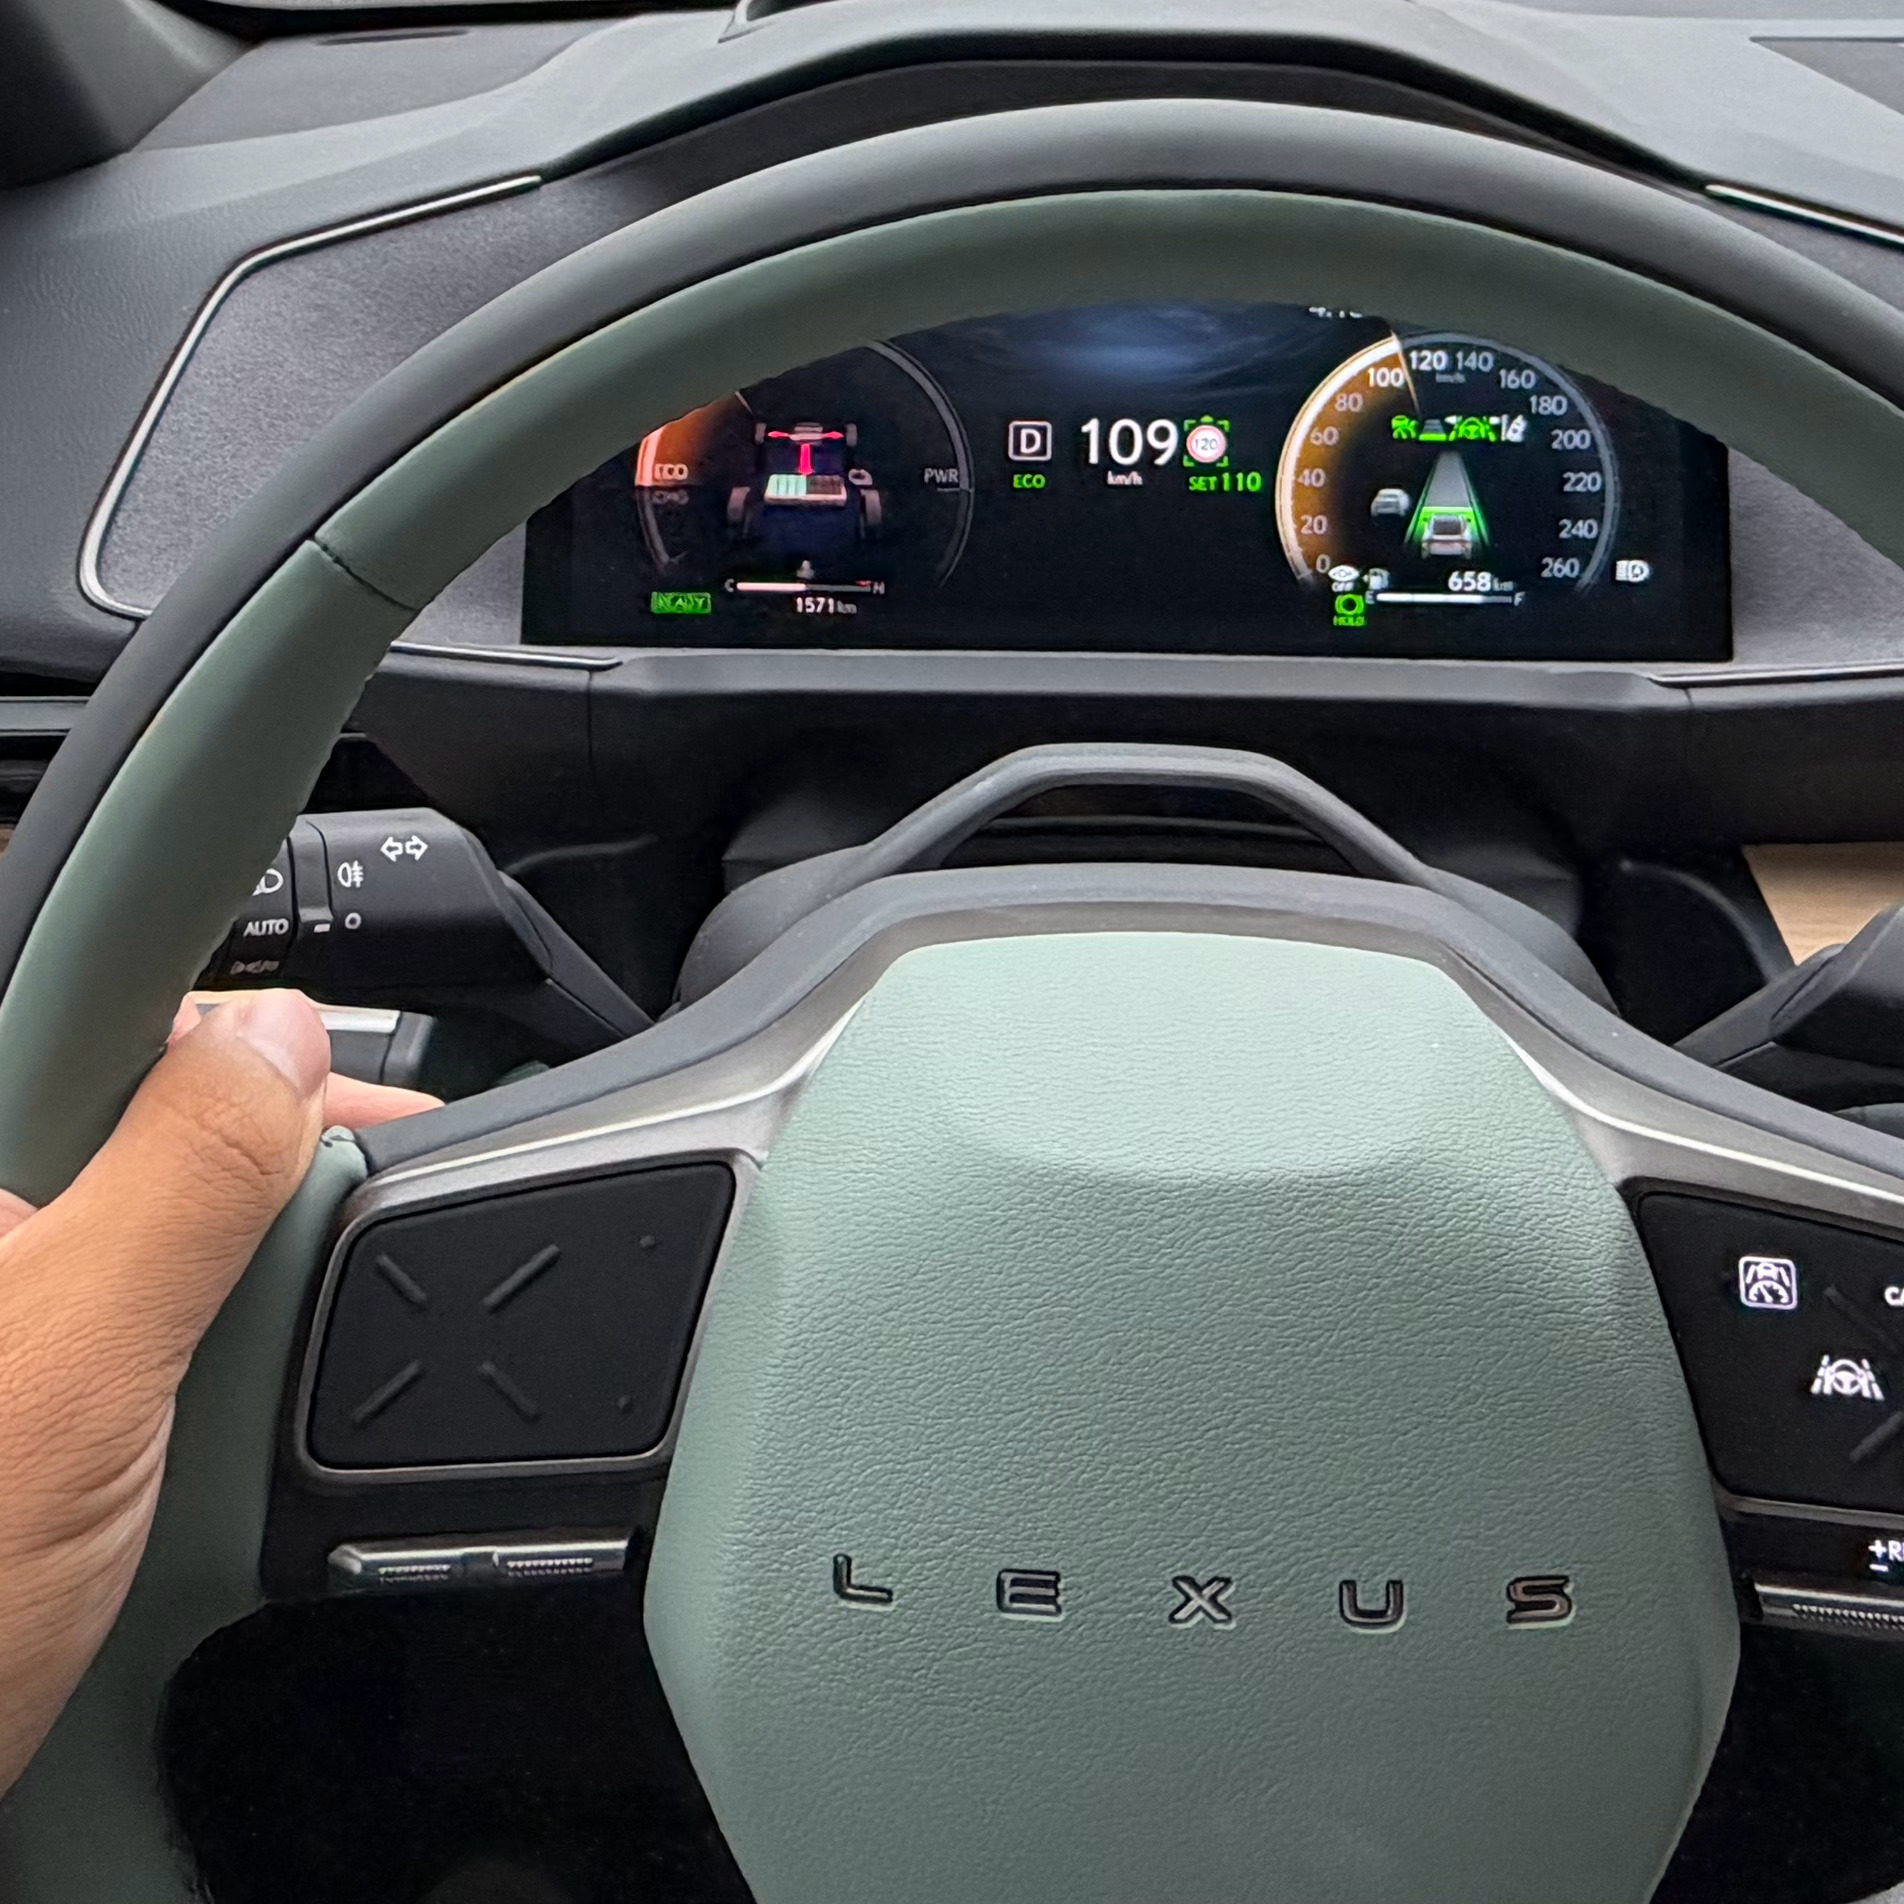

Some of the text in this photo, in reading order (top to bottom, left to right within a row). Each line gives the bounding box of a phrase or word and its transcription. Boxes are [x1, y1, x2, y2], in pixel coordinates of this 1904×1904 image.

[1409, 350, 1446, 370] 120
[1456, 351, 1494, 371] 140
[1367, 368, 1405, 388] 100
[1499, 369, 1536, 389] 160
[1335, 393, 1363, 412] 80
[1530, 395, 1568, 415] 180
[1020, 428, 1041, 454] D
[1081, 418, 1178, 465] 109
[1194, 438, 1218, 451] 120
[1310, 426, 1339, 445] 60
[1551, 429, 1591, 449] 200
[654, 464, 688, 480] ECO
[924, 468, 960, 484] PWR
[1013, 473, 1045, 488] ECO
[1107, 470, 1143, 485] km/h
[1189, 472, 1261, 491] SET 110
[1298, 469, 1325, 488] 40
[1563, 472, 1601, 492] 220
[1301, 516, 1327, 534] 20
[1558, 519, 1596, 539] 240
[1316, 555, 1331, 573] 0
[1541, 557, 1580, 578] 260
[1448, 571, 1491, 591] 658
[796, 597, 835, 613] 1571
[243, 918, 289, 937] AUTO
[832, 1553, 1573, 1631] LEXUS
